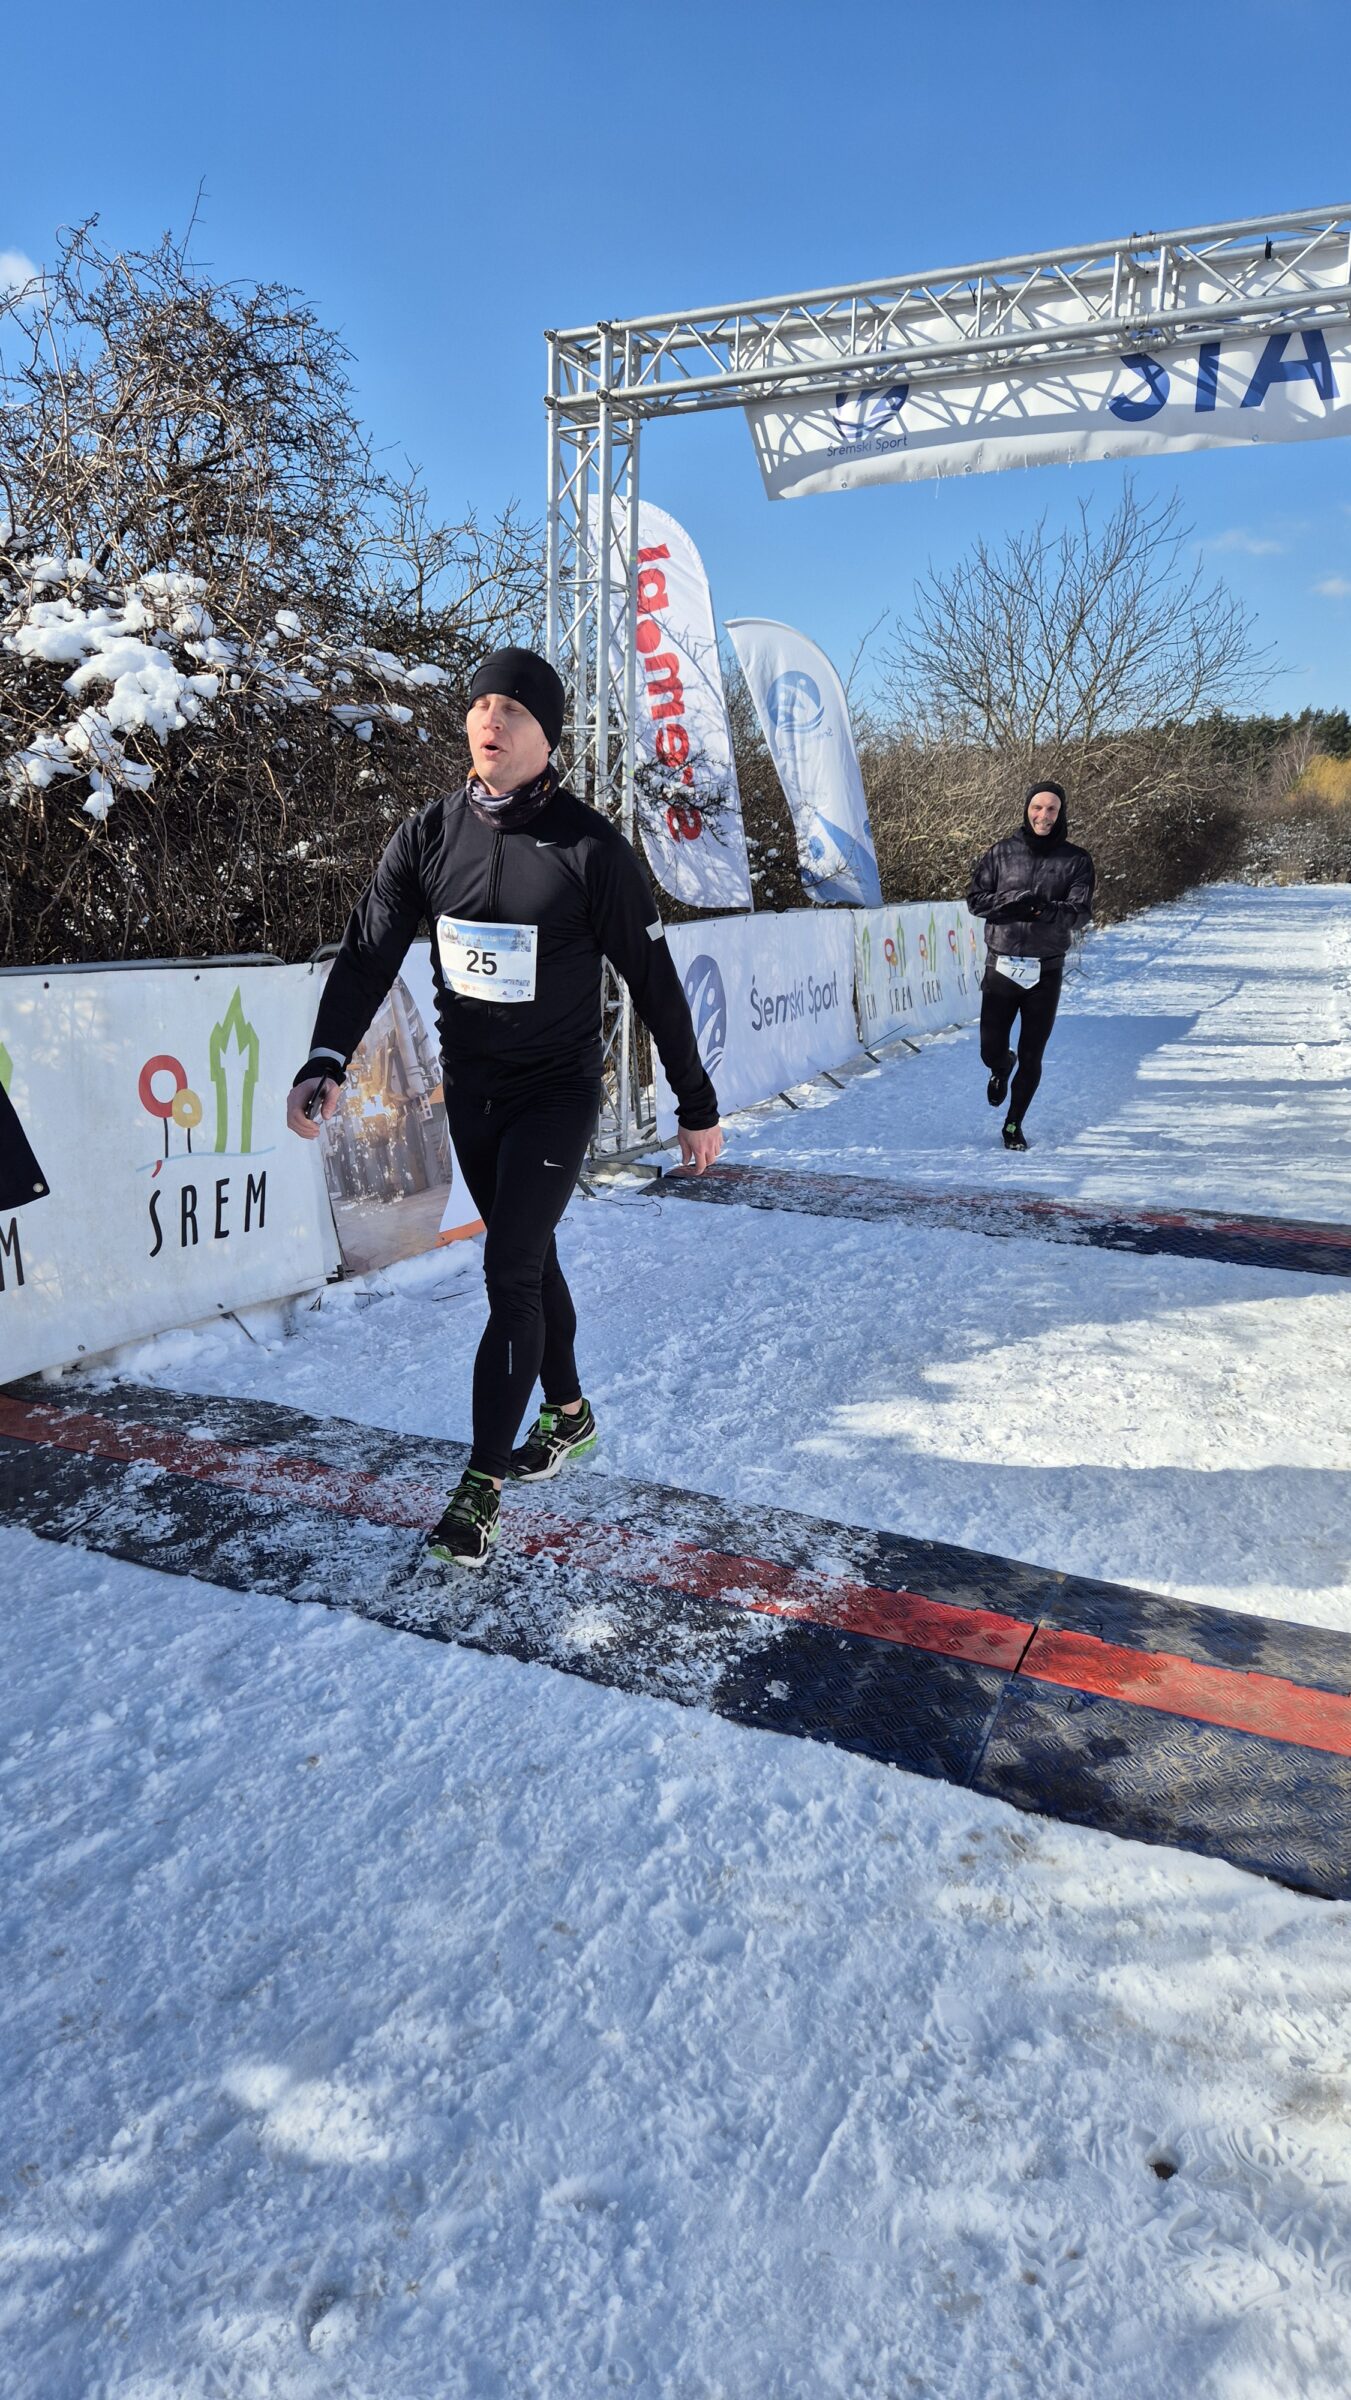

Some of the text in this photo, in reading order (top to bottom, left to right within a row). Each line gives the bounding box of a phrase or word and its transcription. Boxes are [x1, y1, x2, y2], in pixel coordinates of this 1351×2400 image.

[827, 435, 908, 457] Śremski Sport
[466, 949, 498, 976] 25
[1011, 967, 1026, 978] 77
[807, 970, 839, 1025] Sport
[149, 1159, 267, 1258] ŚREM
